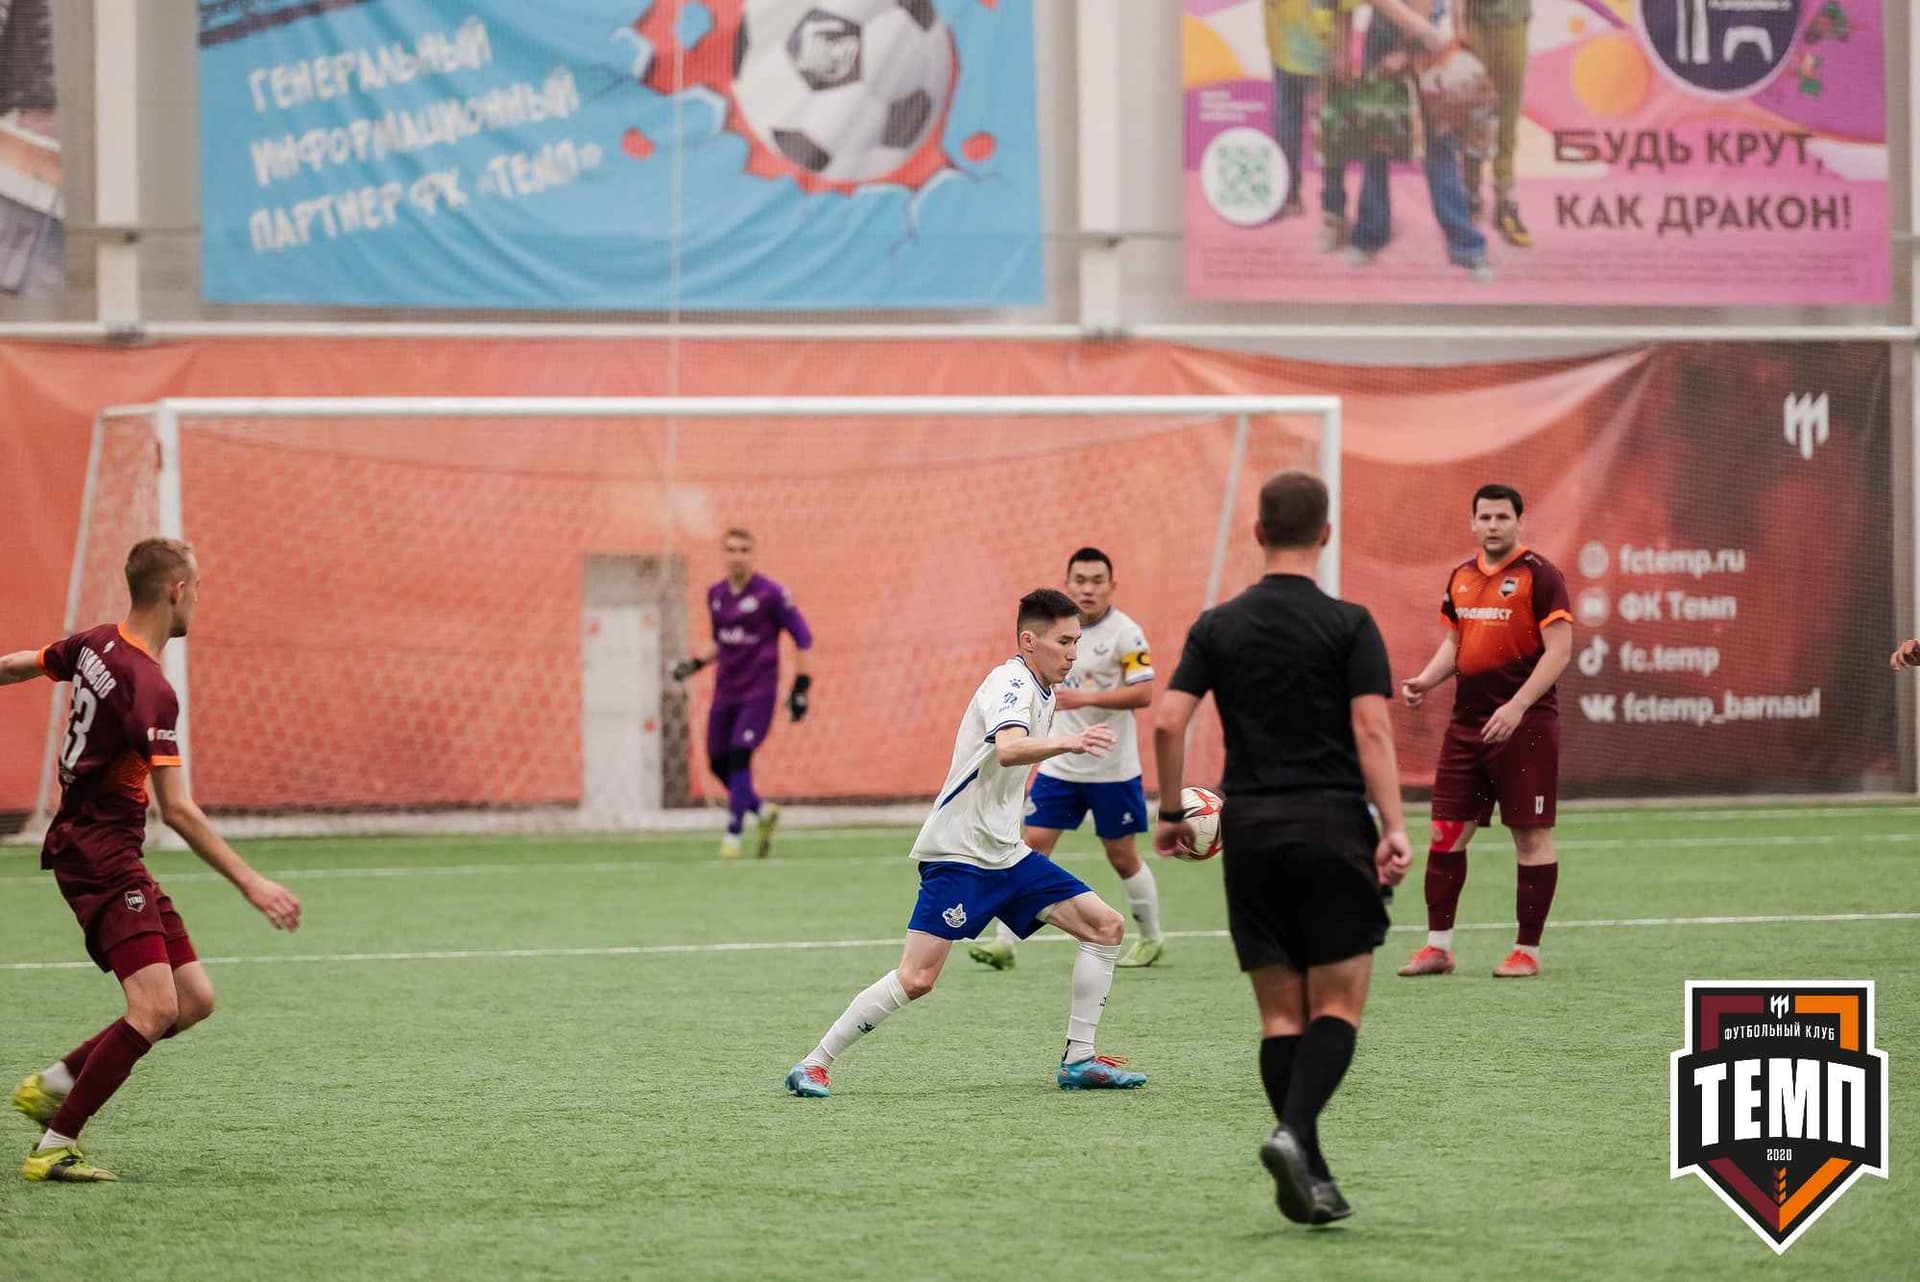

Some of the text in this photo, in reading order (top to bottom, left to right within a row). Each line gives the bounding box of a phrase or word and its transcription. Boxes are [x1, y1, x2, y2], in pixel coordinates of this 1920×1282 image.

[248, 15, 493, 112] ГЕНЕРАЛЬНЫЙ
[250, 66, 579, 187] ИНФОРМАЦИОННЫЙ
[1554, 130, 1824, 175] БУДЬ КРУТ,
[249, 181, 402, 254] ПАРТНЕР
[410, 165, 468, 215] ФК
[1555, 194, 1852, 237] КАК ДРАКОН!
[1620, 543, 1745, 579] fctemp.ru
[1618, 590, 1737, 622] ФК Темп
[1619, 641, 1720, 677] fc.temp
[1622, 688, 1821, 728] fctemp_barnaul
